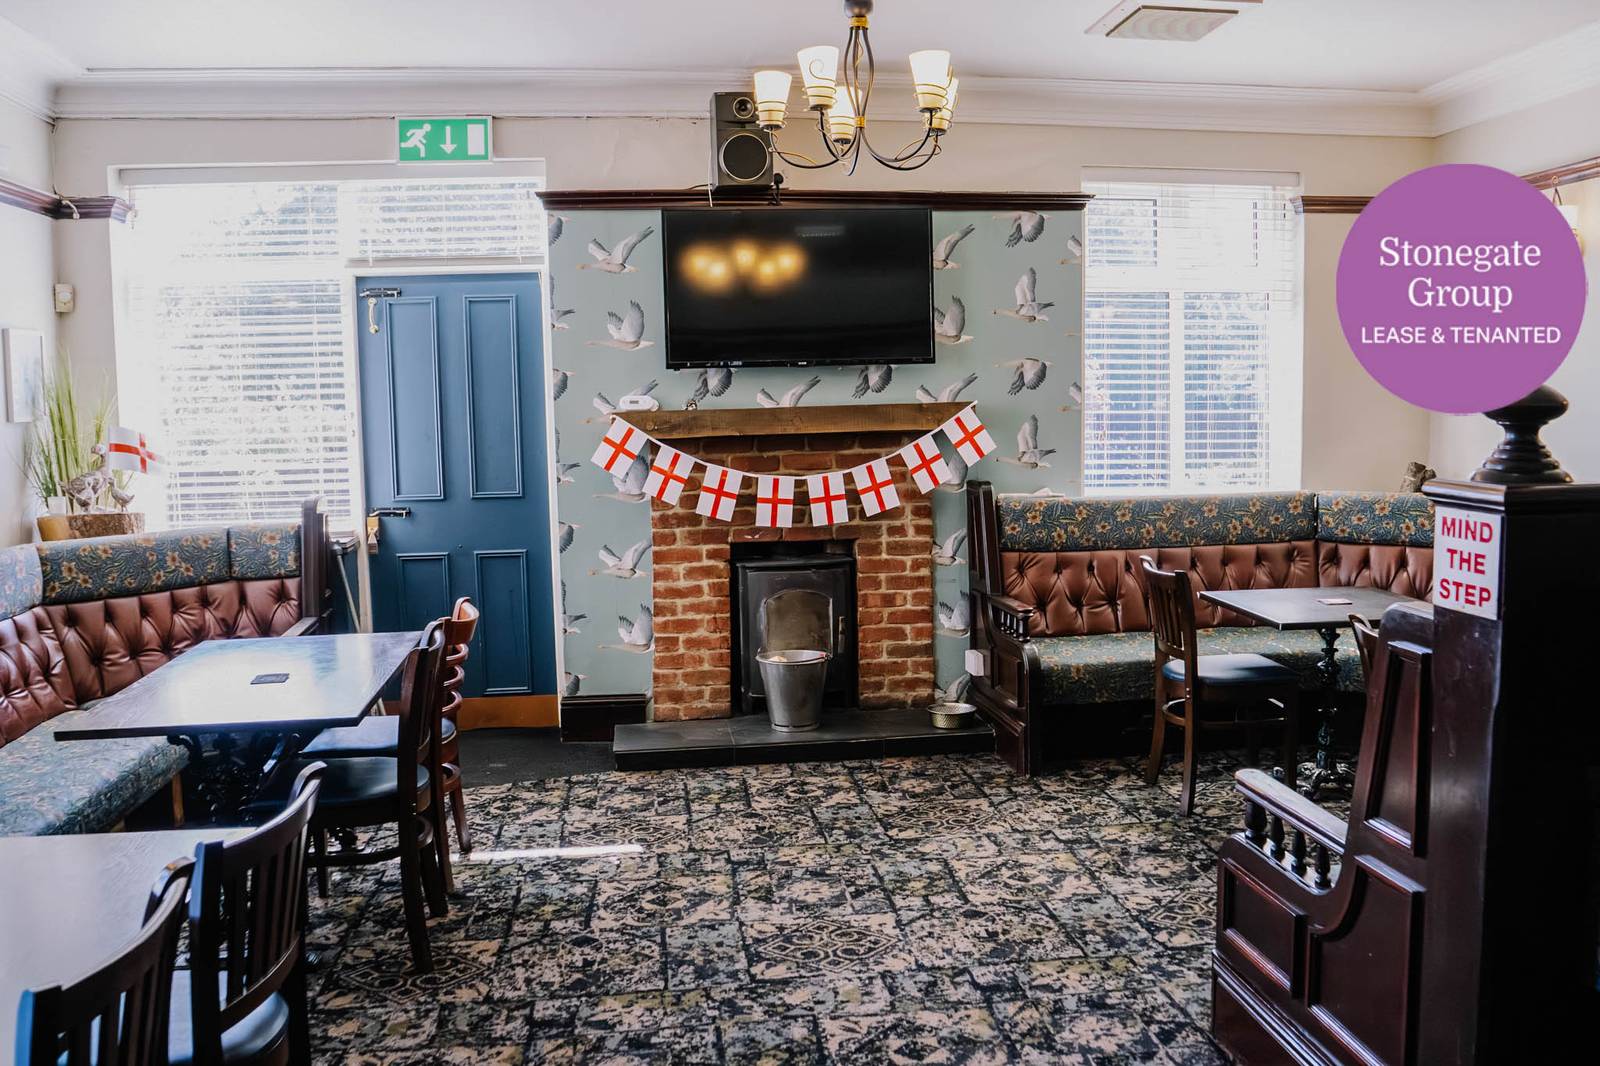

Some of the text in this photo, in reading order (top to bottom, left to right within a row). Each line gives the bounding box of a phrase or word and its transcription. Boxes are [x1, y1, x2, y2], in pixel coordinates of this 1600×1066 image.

[1441, 516, 1493, 543] MIND
[1447, 548, 1486, 575] THE
[1439, 578, 1492, 607] STEP
